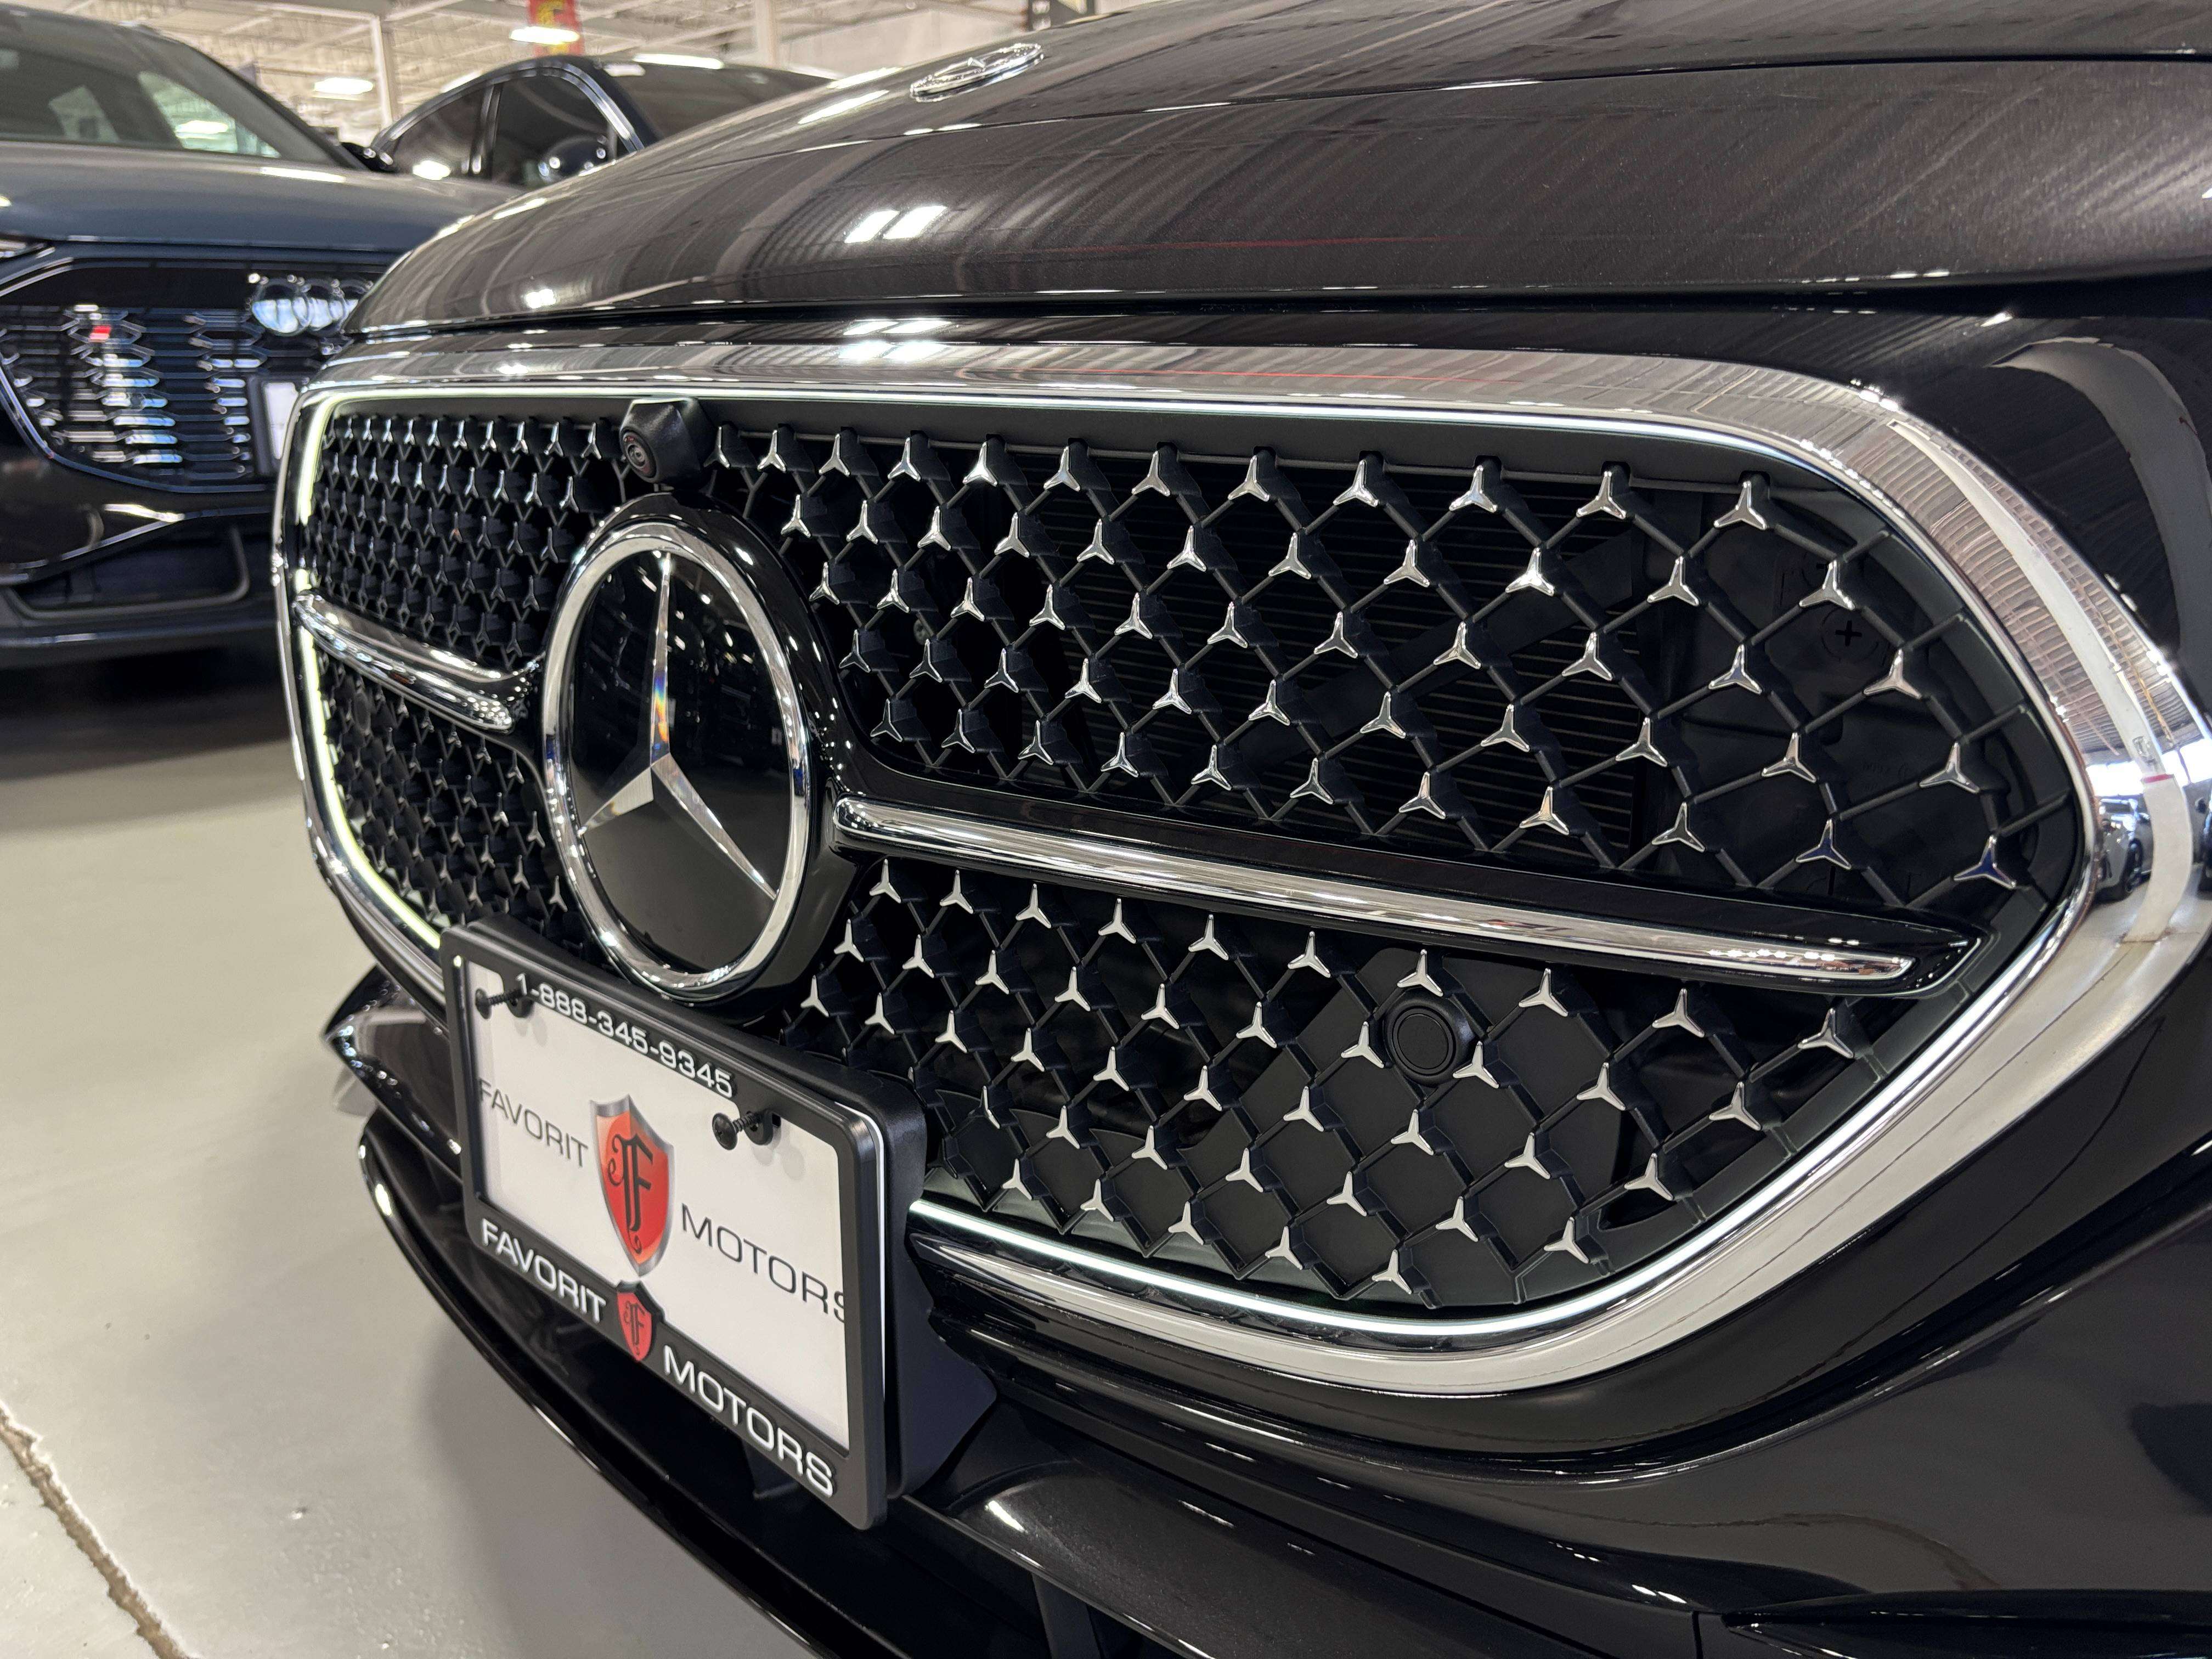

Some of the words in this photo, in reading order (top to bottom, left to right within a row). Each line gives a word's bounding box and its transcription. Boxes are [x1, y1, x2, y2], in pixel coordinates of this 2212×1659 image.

[516, 973, 733, 1098] 1-888-345-9345
[478, 1078, 589, 1168] FAVORIT
[481, 1217, 607, 1323] FAVORIT
[663, 1345, 834, 1498] MOTORS
